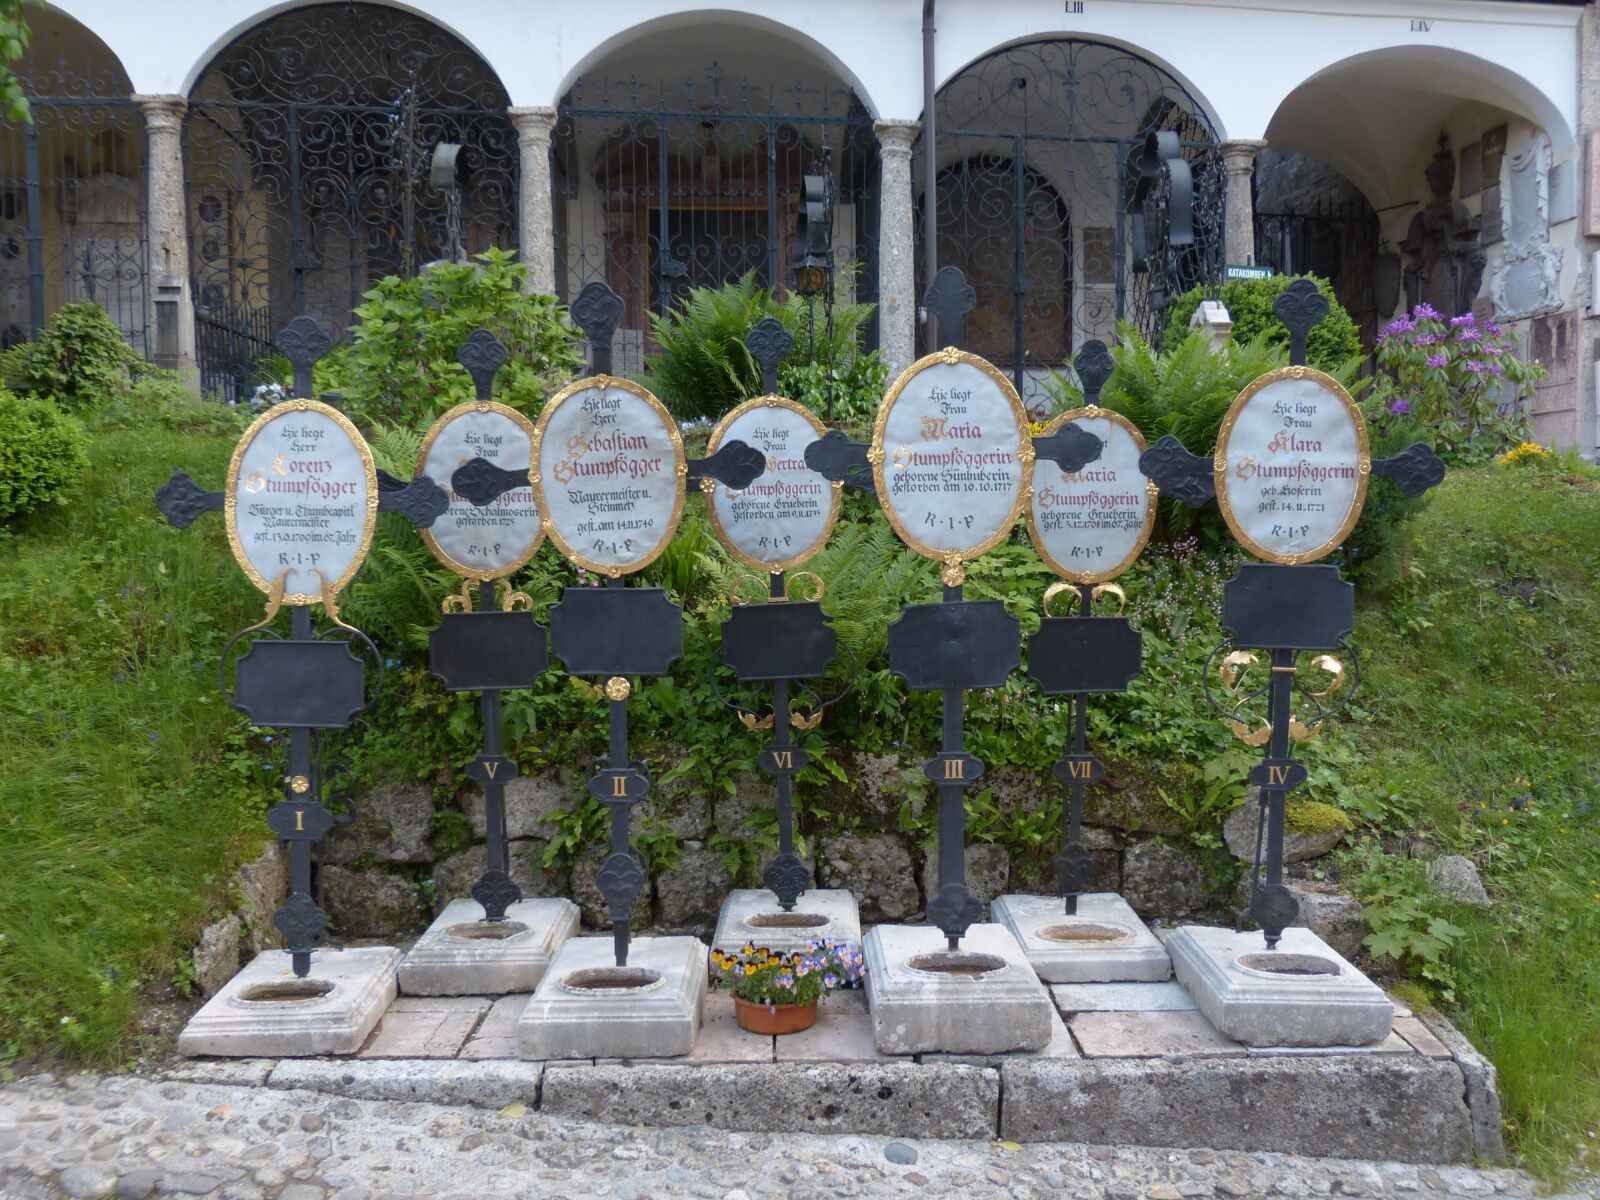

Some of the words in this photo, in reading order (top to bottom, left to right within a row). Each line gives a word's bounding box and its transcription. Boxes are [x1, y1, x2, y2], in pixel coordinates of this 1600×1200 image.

[1410, 19, 1434, 32] LIV
[1228, 267, 1266, 279] KATAKOMBEN
[950, 387, 972, 403] liegt
[940, 401, 967, 416] Frau
[1295, 400, 1317, 416] liegt
[920, 415, 982, 442] Maria
[1283, 416, 1312, 428] Frau
[301, 426, 325, 441] liegt
[483, 433, 503, 448] liegt
[290, 440, 317, 455] Herr
[763, 440, 787, 453] Frau
[1267, 430, 1322, 455] Klara
[475, 445, 498, 457] Frau
[893, 470, 939, 484] geborene
[943, 483, 960, 493] am
[776, 511, 791, 519] am
[598, 520, 615, 531] am
[771, 751, 793, 769] VI
[483, 761, 500, 780] V
[943, 759, 965, 779] III
[1066, 760, 1093, 780] VII
[1268, 765, 1293, 785] IV
[611, 776, 628, 797] II
[295, 811, 305, 831] I
